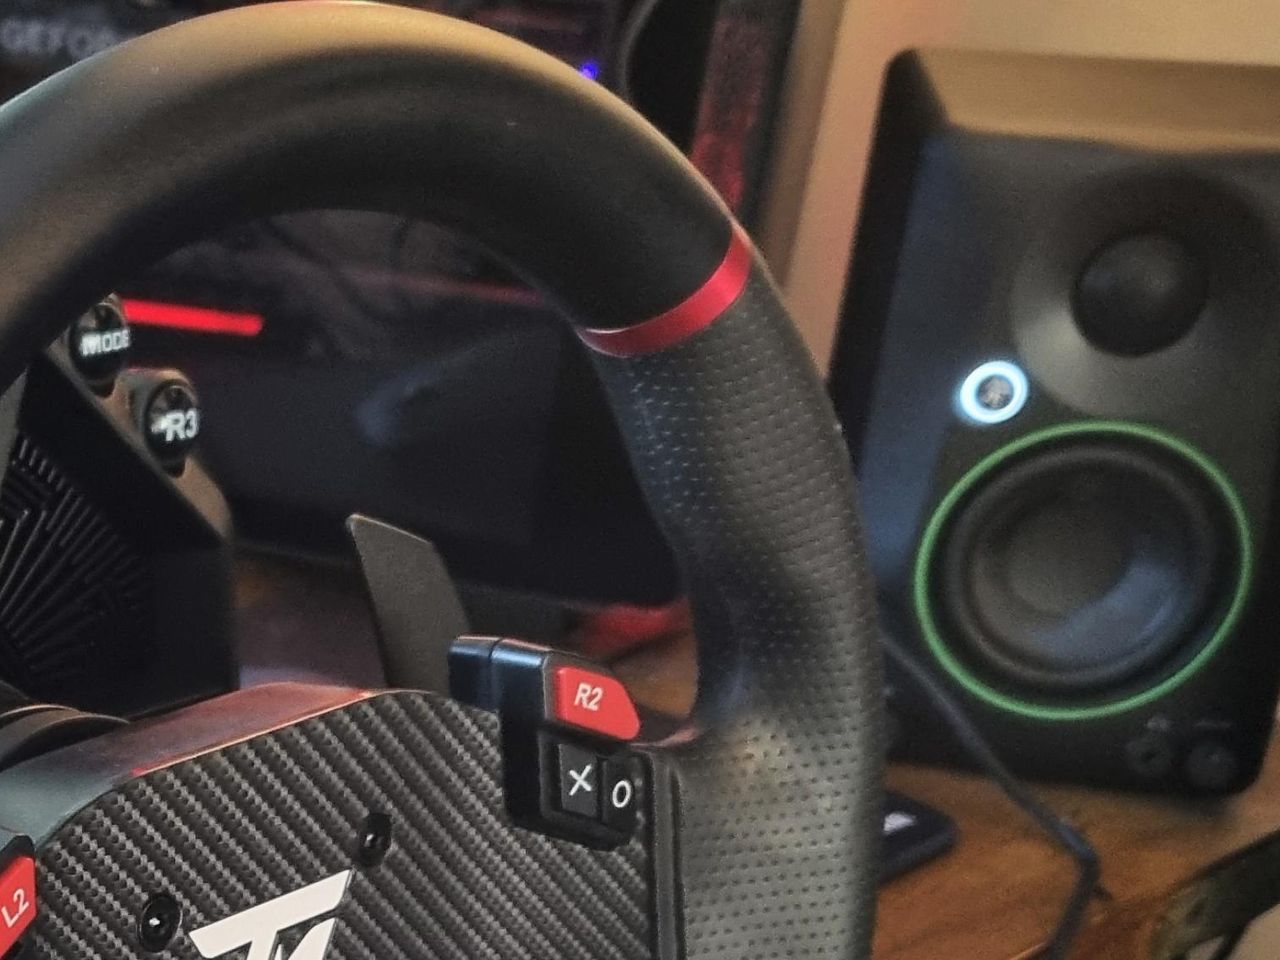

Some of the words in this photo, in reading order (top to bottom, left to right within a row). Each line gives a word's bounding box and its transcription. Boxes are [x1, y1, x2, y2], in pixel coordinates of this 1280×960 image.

[80, 328, 129, 357] MODE
[574, 682, 603, 712] R2
[1, 888, 29, 928] L2
